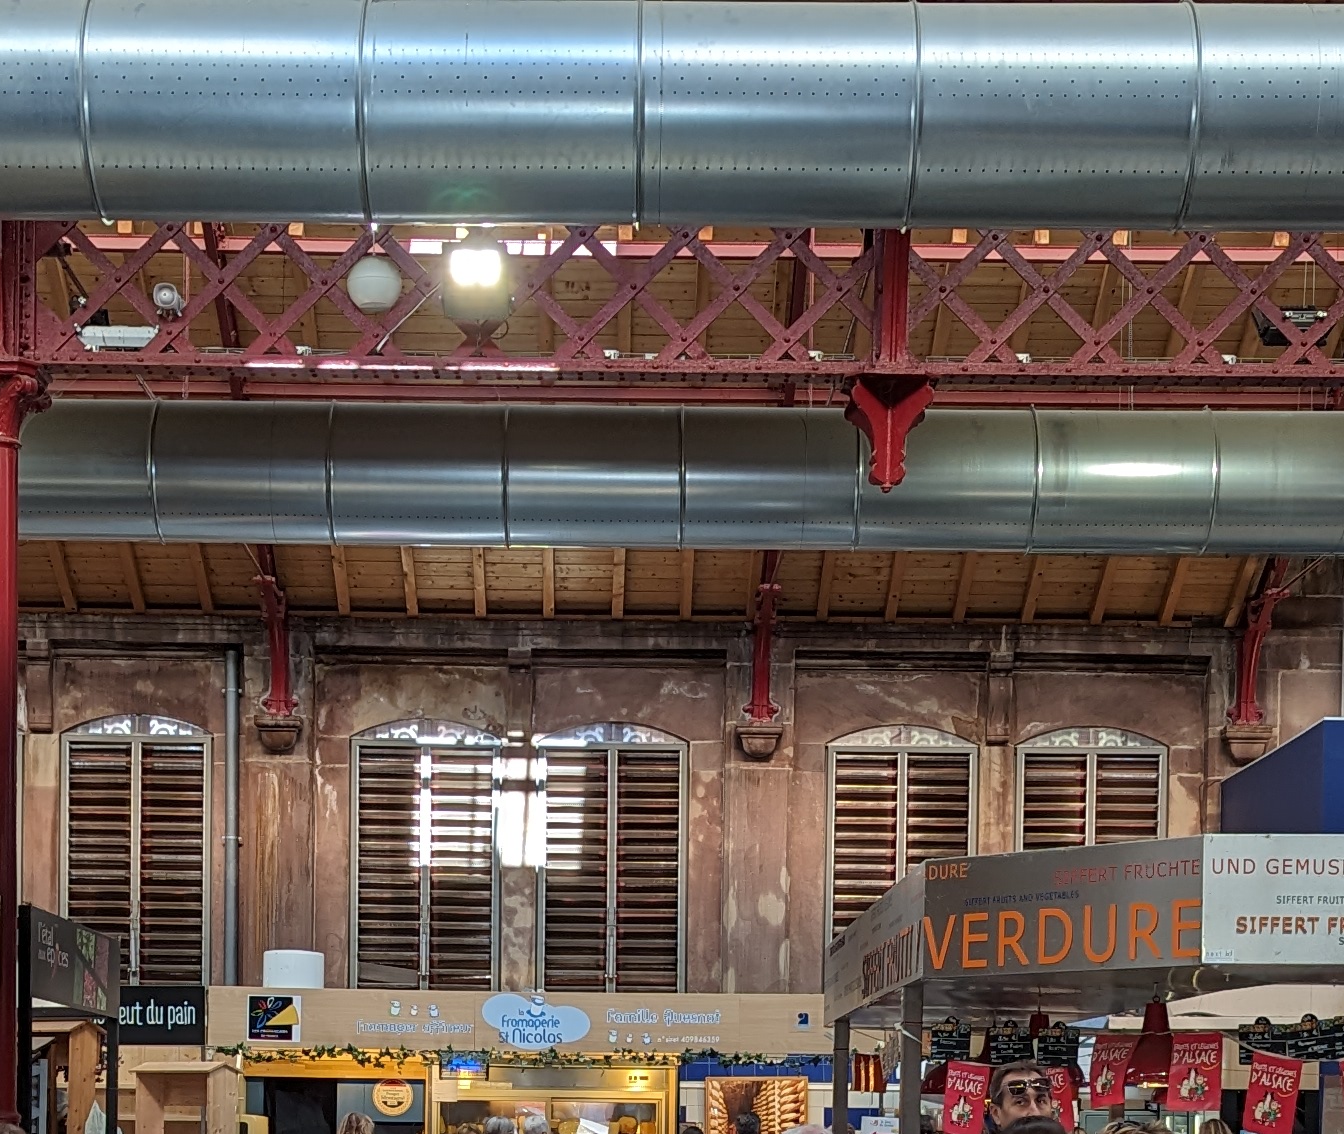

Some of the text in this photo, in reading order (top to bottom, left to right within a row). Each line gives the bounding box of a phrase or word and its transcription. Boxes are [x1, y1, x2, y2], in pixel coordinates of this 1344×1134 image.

[925, 863, 968, 880] DURE
[1124, 859, 1201, 881] FRUCHTE
[1212, 858, 1256, 875] UND
[1276, 895, 1314, 905] SIFFERT
[923, 898, 1202, 970] VERDURE
[1235, 916, 1320, 935] SIFFERT
[119, 999, 196, 1029] eut du pain
[499, 1028, 562, 1043] St Nicolas
[1172, 1050, 1217, 1066] D'ALSACE
[947, 1077, 984, 1095] D'ALSACE
[1251, 1071, 1294, 1092] D'ALSACE
